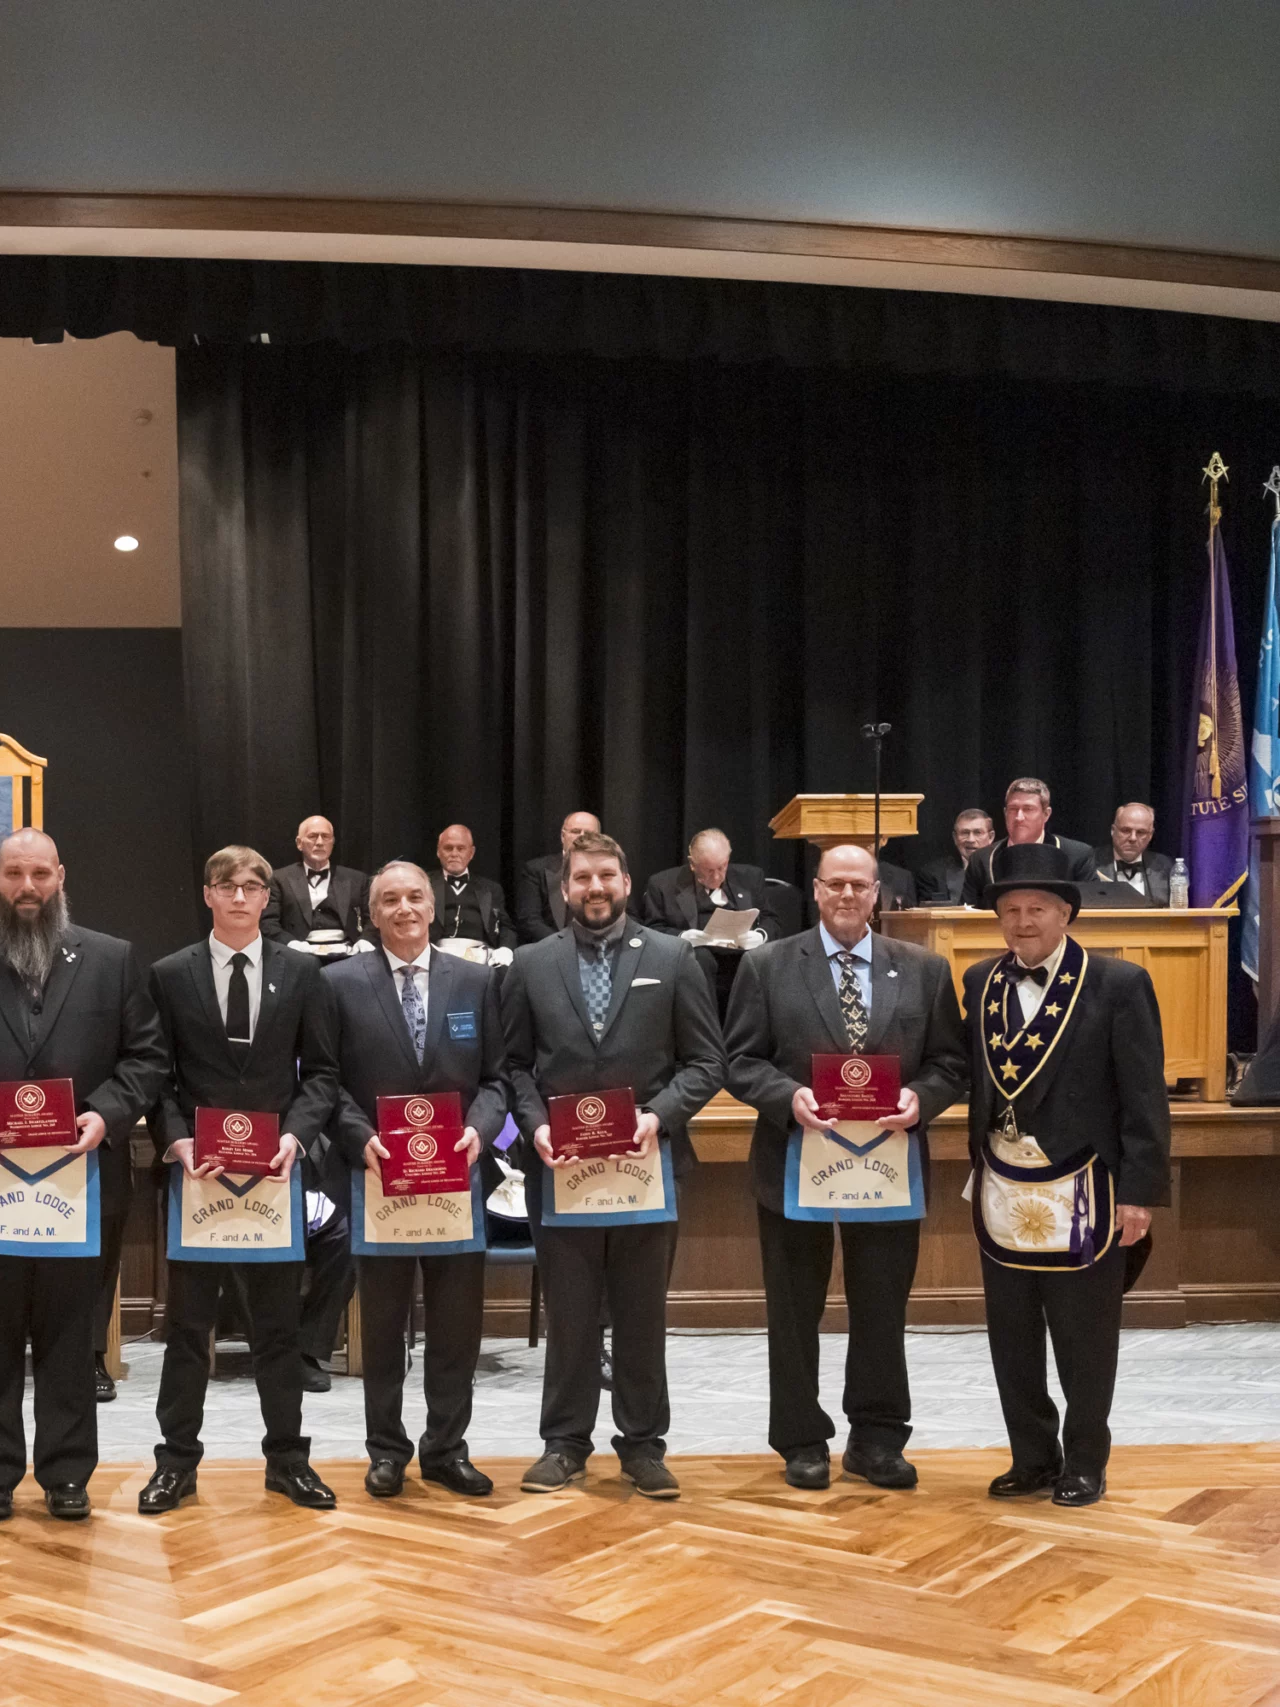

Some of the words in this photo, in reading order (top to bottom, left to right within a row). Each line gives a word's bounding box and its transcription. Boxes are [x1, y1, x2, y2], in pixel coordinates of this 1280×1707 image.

[567, 1162, 606, 1190] GRAND
[616, 1161, 654, 1186] LODGE
[811, 1158, 854, 1186] GRAND
[864, 1158, 898, 1184] LODGE
[585, 1198, 594, 1206] F.
[598, 1198, 612, 1206] and
[628, 1195, 638, 1204] M.
[828, 1191, 838, 1200] F.
[842, 1192, 859, 1200] and
[862, 1192, 872, 1200] A.
[874, 1191, 884, 1200] M.
[35, 1191, 76, 1220] LODGE
[192, 1198, 234, 1225] GRAND
[244, 1198, 283, 1226] LODGE
[427, 1195, 462, 1219] LODGE
[0, 1224, 8, 1234] F.
[12, 1226, 30, 1236] and
[34, 1228, 44, 1236] A.
[46, 1227, 56, 1236] M.
[210, 1232, 218, 1242] F.
[222, 1234, 238, 1242] and
[242, 1234, 251, 1242] A.
[254, 1232, 264, 1242] M.
[394, 1228, 402, 1236] F.
[406, 1228, 422, 1237] and
[426, 1228, 434, 1236] A.
[437, 1228, 446, 1236] M.
